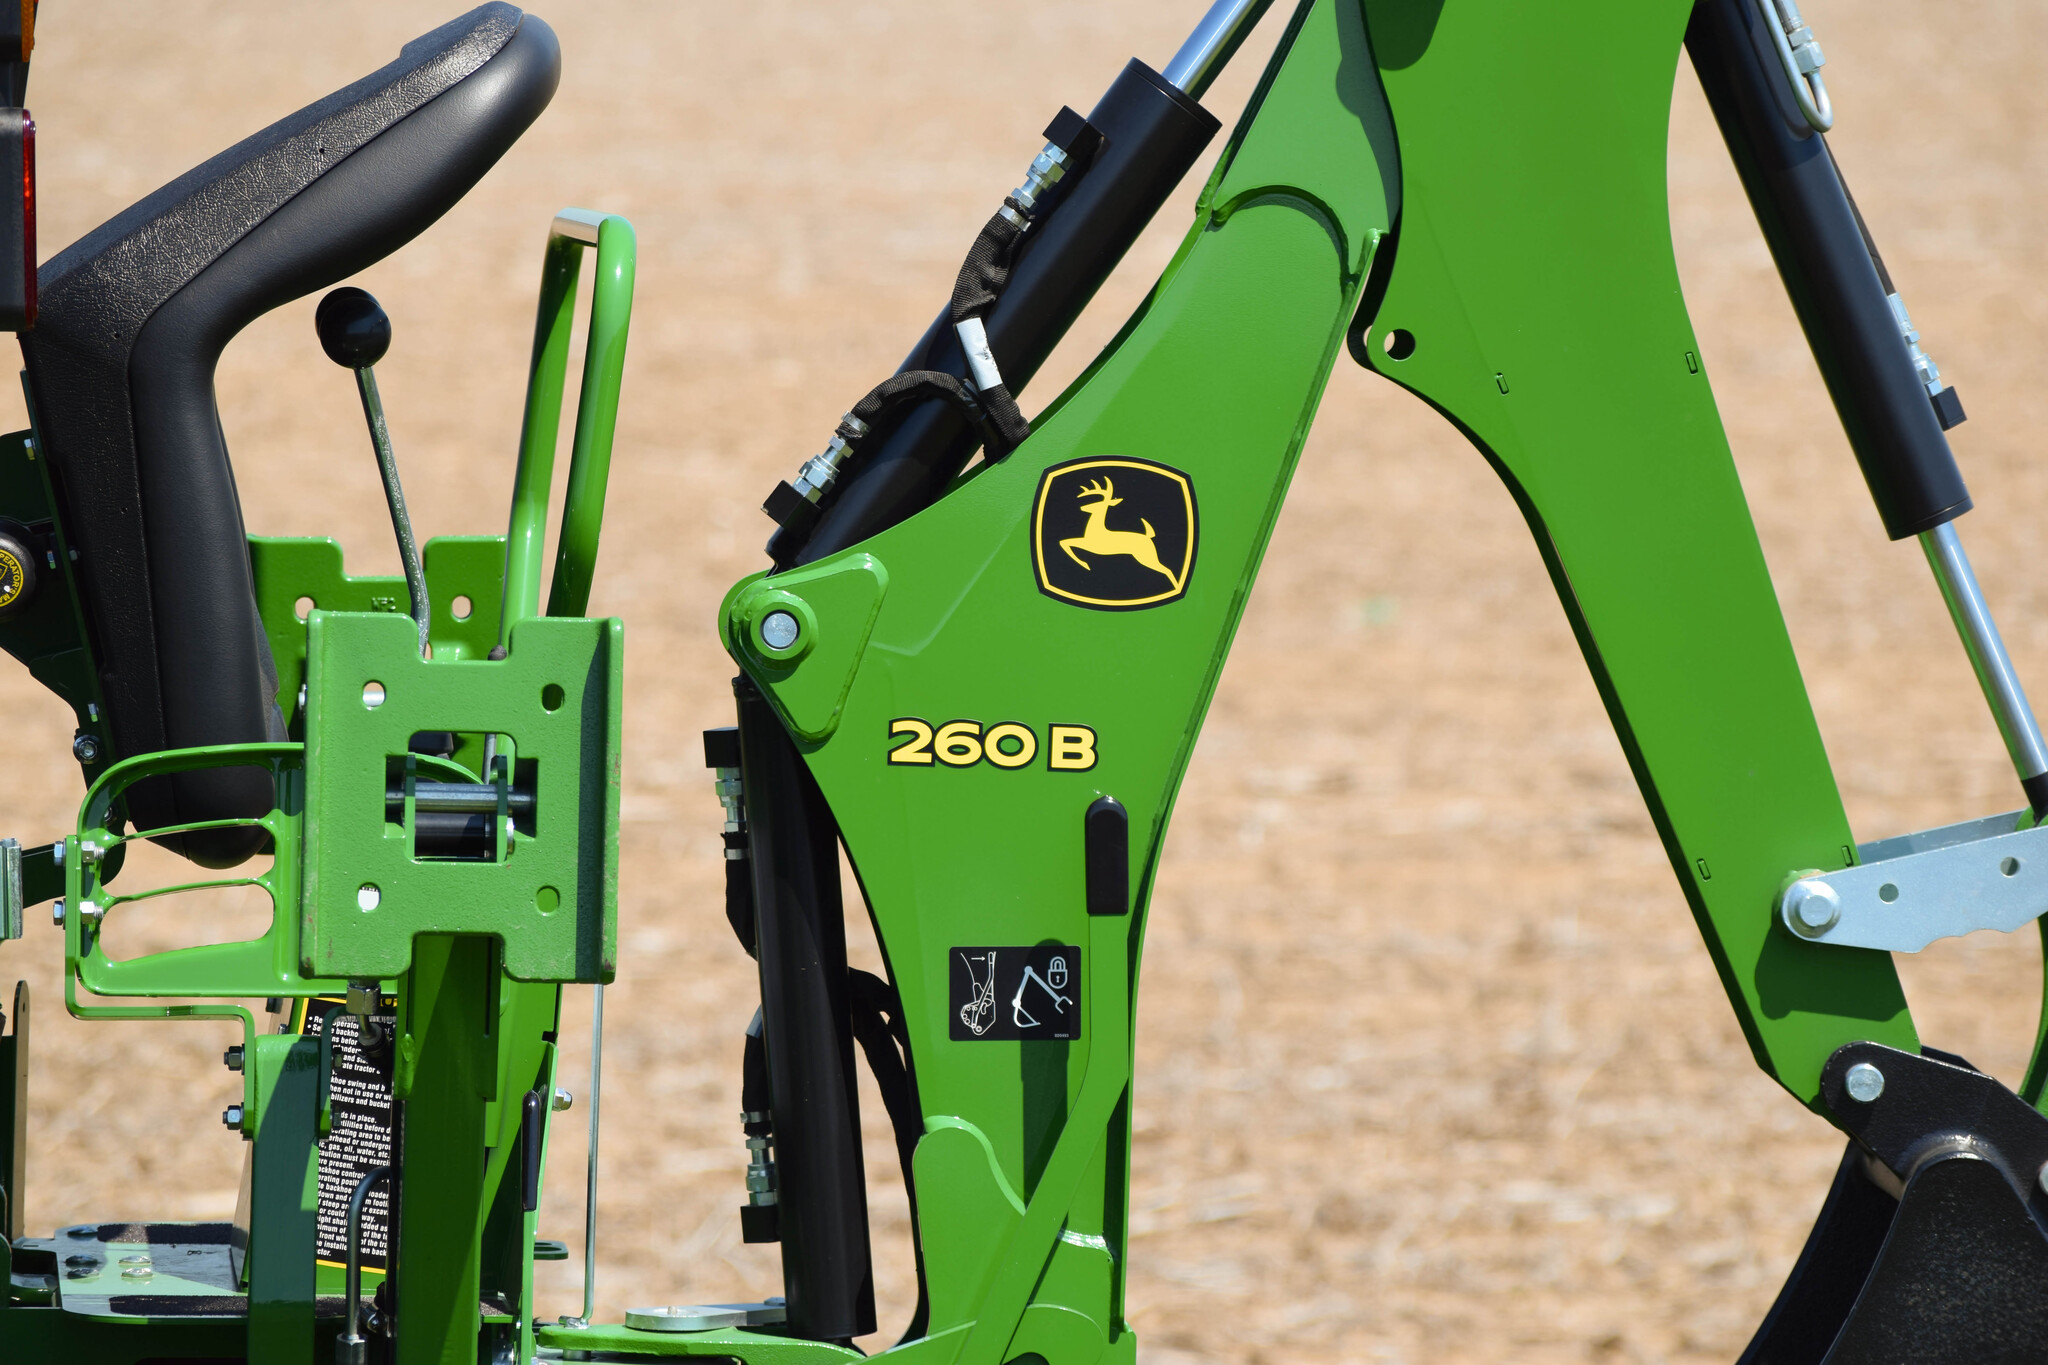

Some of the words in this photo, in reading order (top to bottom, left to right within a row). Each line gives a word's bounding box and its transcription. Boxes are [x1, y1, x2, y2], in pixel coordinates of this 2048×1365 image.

[888, 716, 1039, 770] 260
[1047, 722, 1098, 772] B
[354, 1064, 375, 1073] tractor
[348, 1080, 366, 1090] swing
[368, 1083, 379, 1091] and
[356, 1098, 368, 1106] and
[369, 1099, 390, 1109] bucket
[357, 1114, 377, 1124] place.
[364, 1125, 385, 1134] before
[358, 1131, 373, 1139] area
[329, 1143, 342, 1152] gas,
[344, 1146, 355, 1154] oil,
[357, 1147, 376, 1157] water,
[342, 1153, 358, 1162] must
[329, 1160, 354, 1170] present.
[326, 1183, 352, 1194] backhoe
[322, 1200, 340, 1209] steep
[327, 1209, 345, 1217] could
[319, 1232, 334, 1240] front
